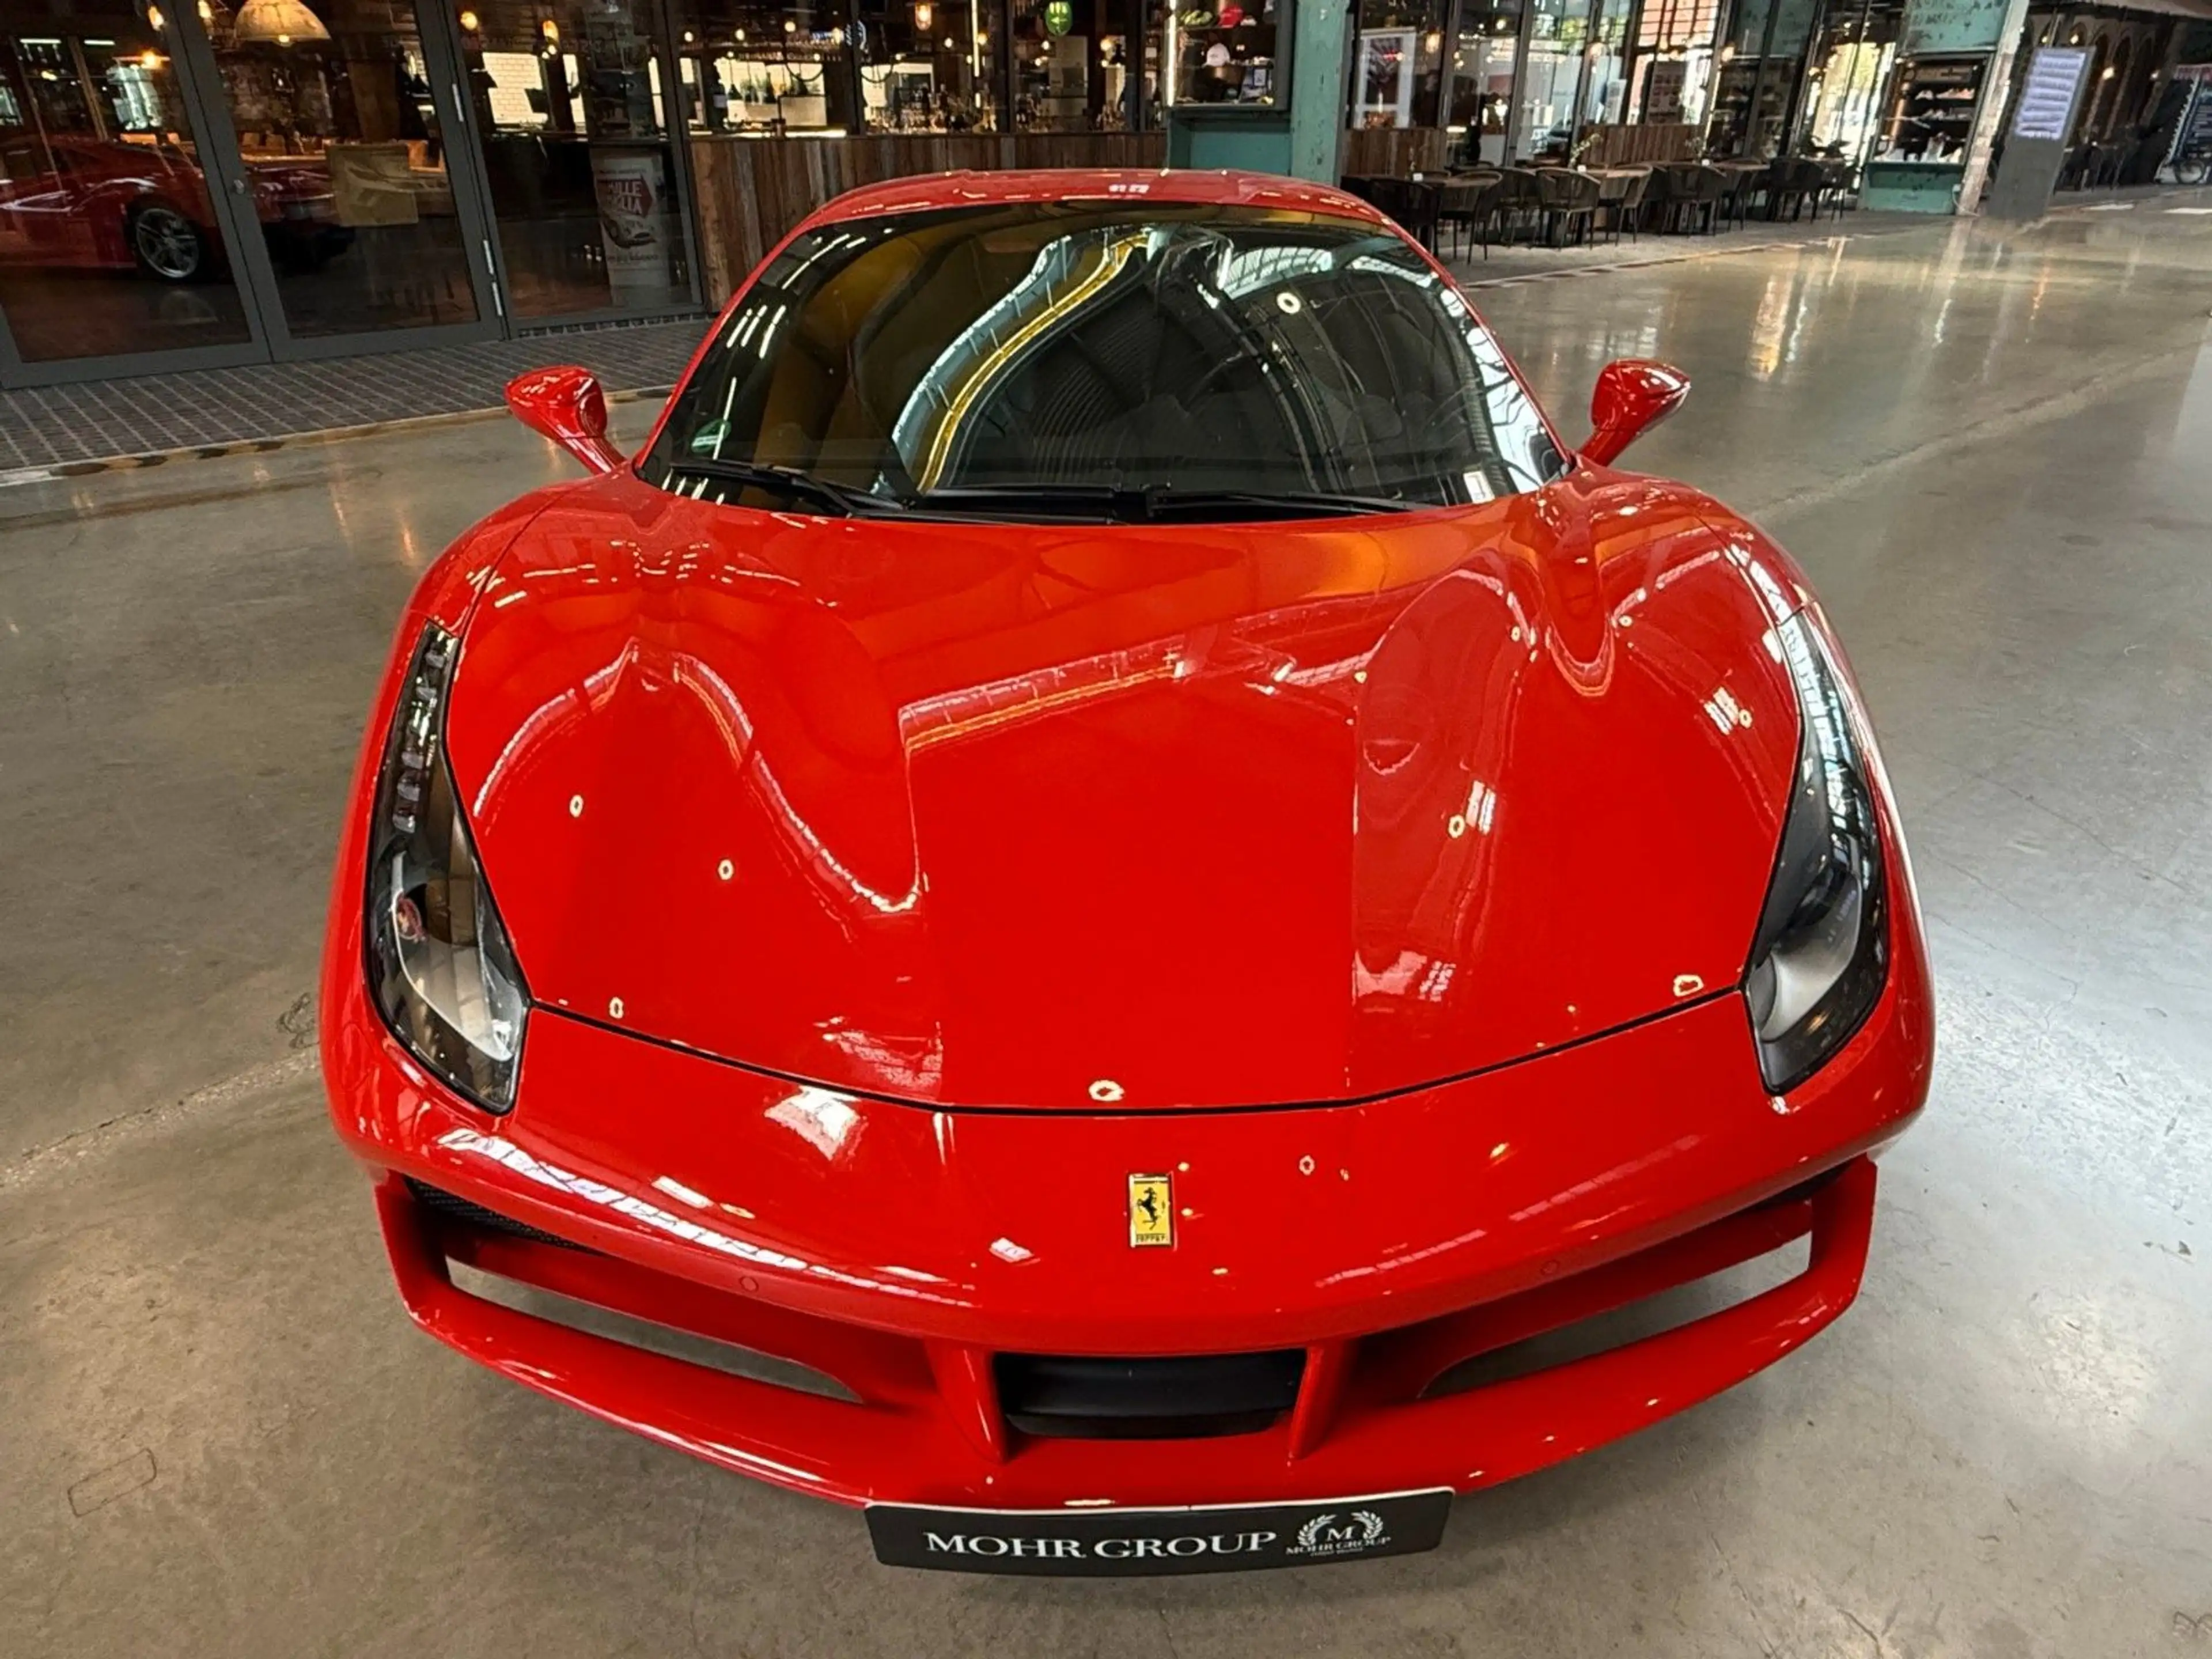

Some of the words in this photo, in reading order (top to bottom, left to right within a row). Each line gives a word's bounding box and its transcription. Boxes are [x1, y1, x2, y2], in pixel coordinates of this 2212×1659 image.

[1327, 1526, 1355, 1541] M
[923, 1532, 1086, 1558] MOHR
[1094, 1532, 1277, 1558] GROUP
